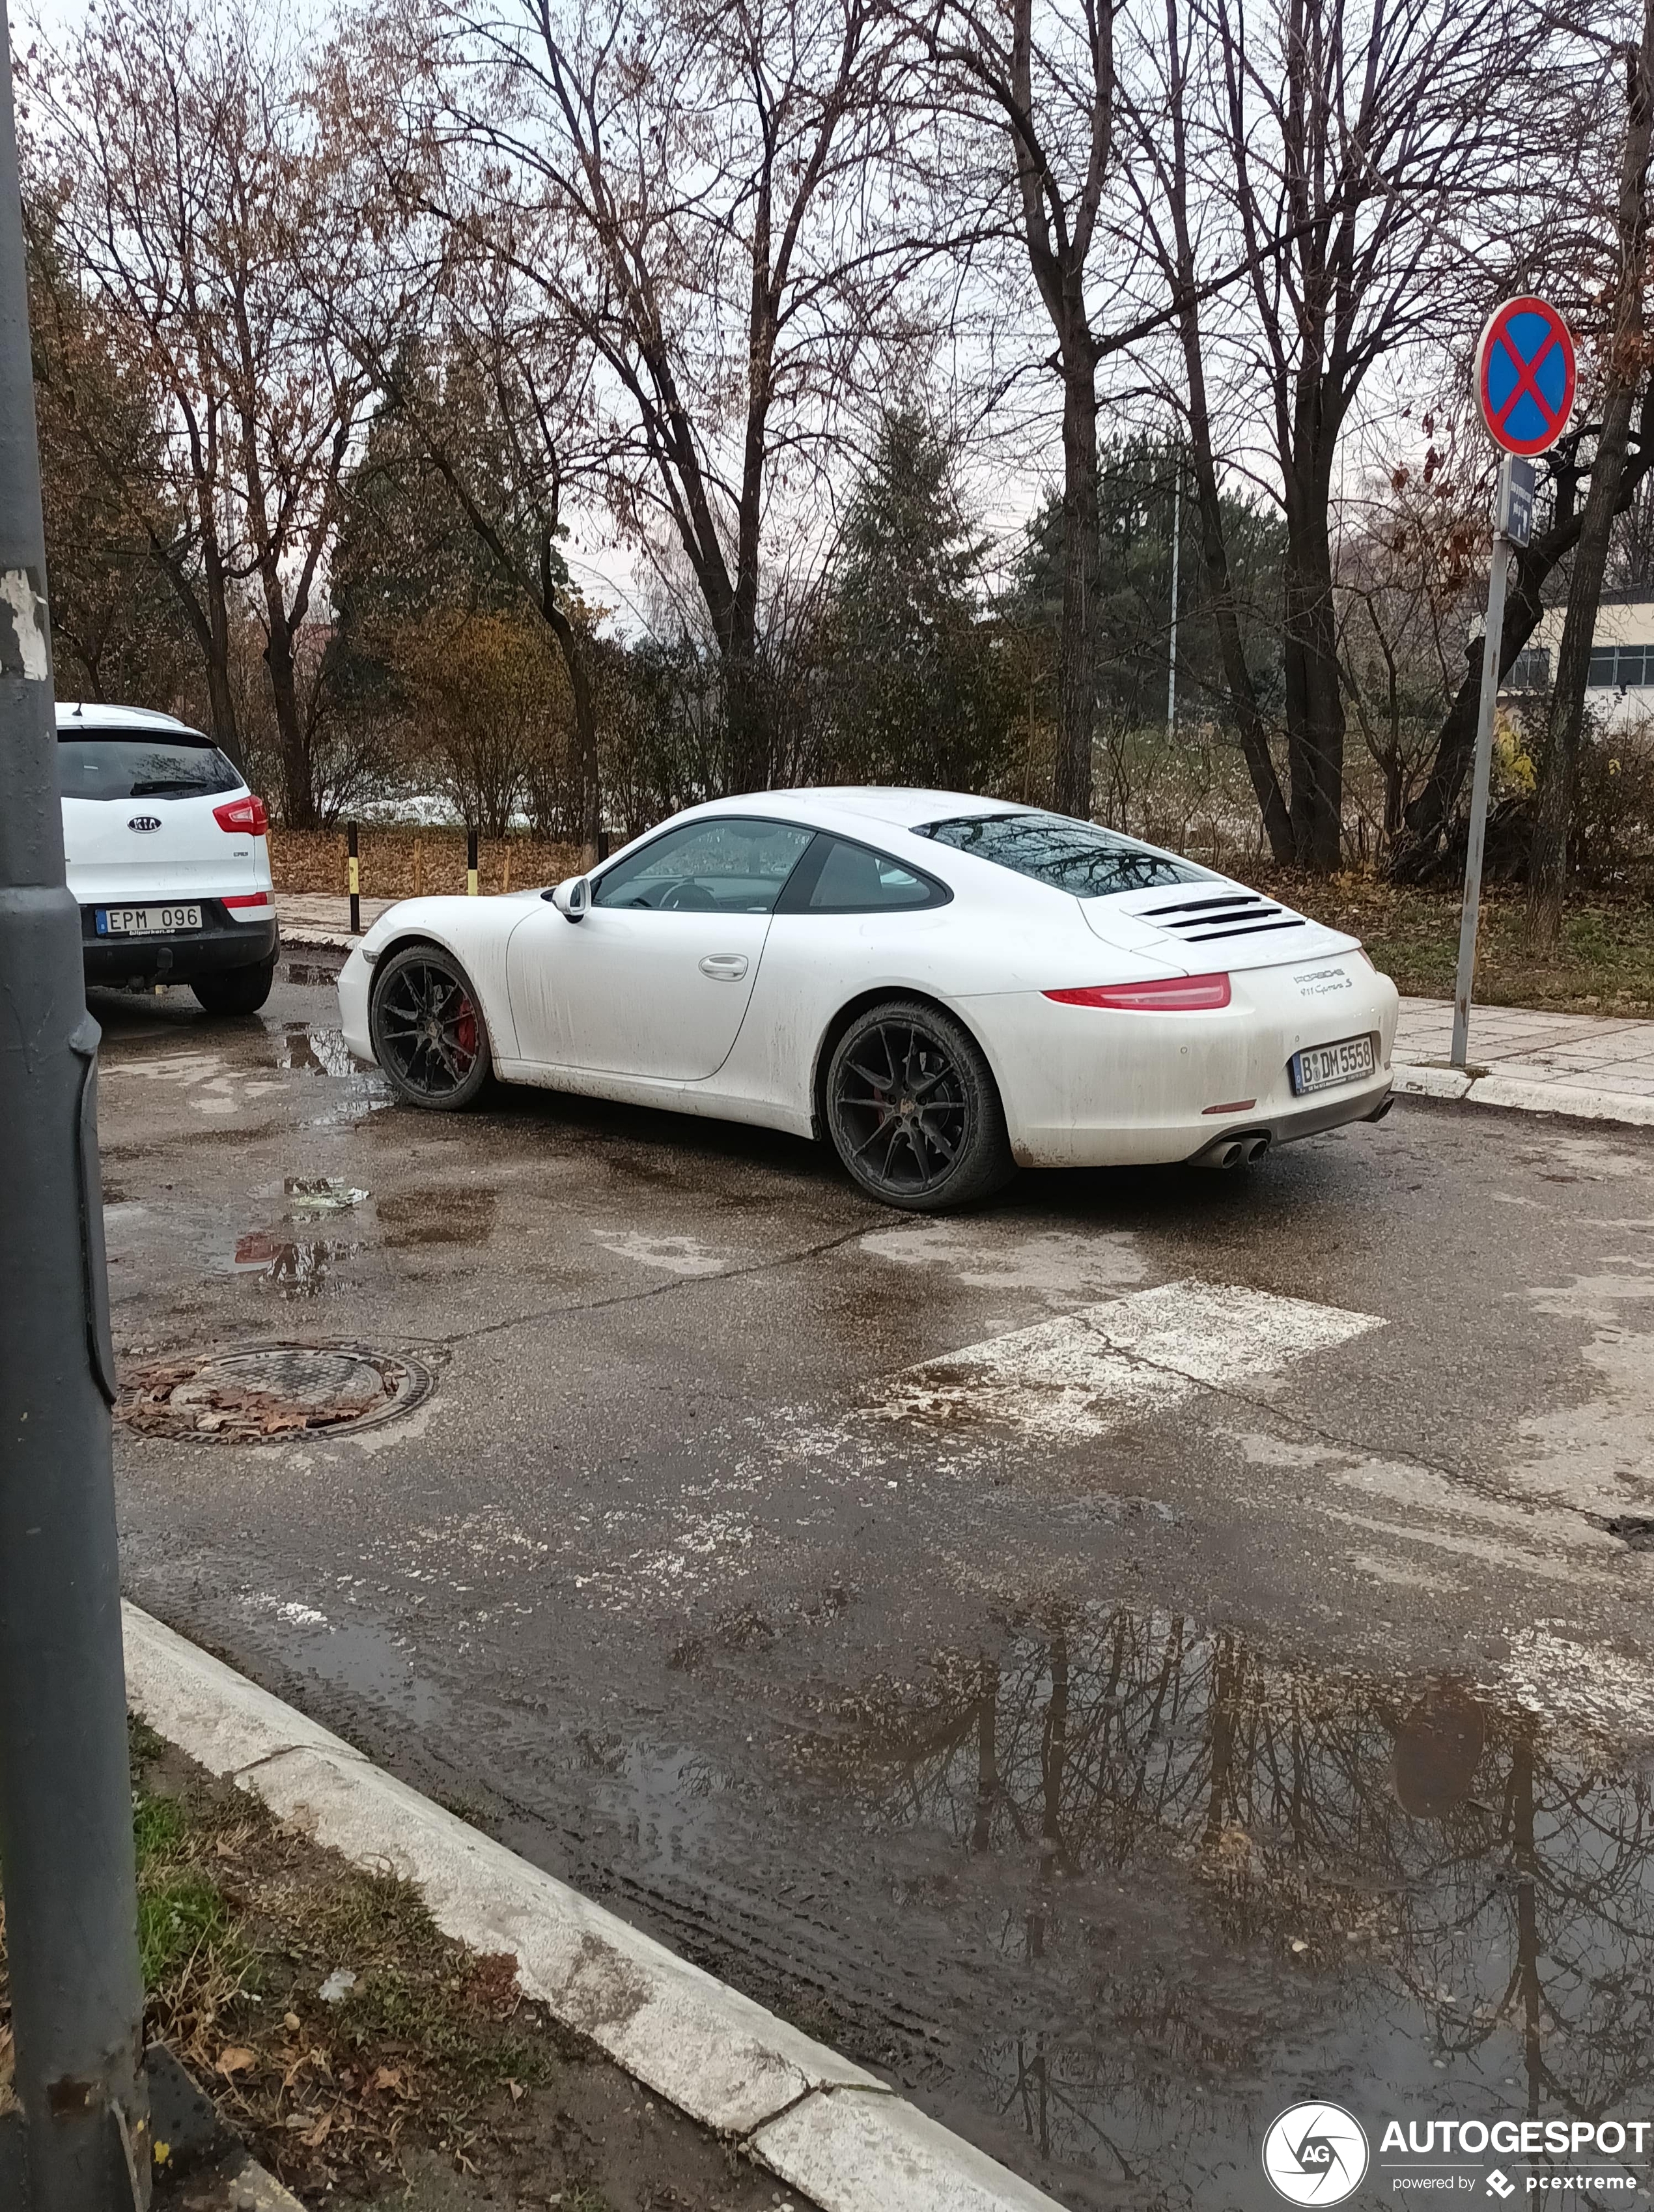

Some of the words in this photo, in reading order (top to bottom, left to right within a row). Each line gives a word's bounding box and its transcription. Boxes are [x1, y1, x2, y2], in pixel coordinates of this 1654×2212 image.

[133, 818, 157, 829] KIA
[109, 911, 147, 930] EPM
[161, 909, 197, 927] 096
[1345, 978, 1353, 988] S
[1302, 1056, 1312, 1083] B
